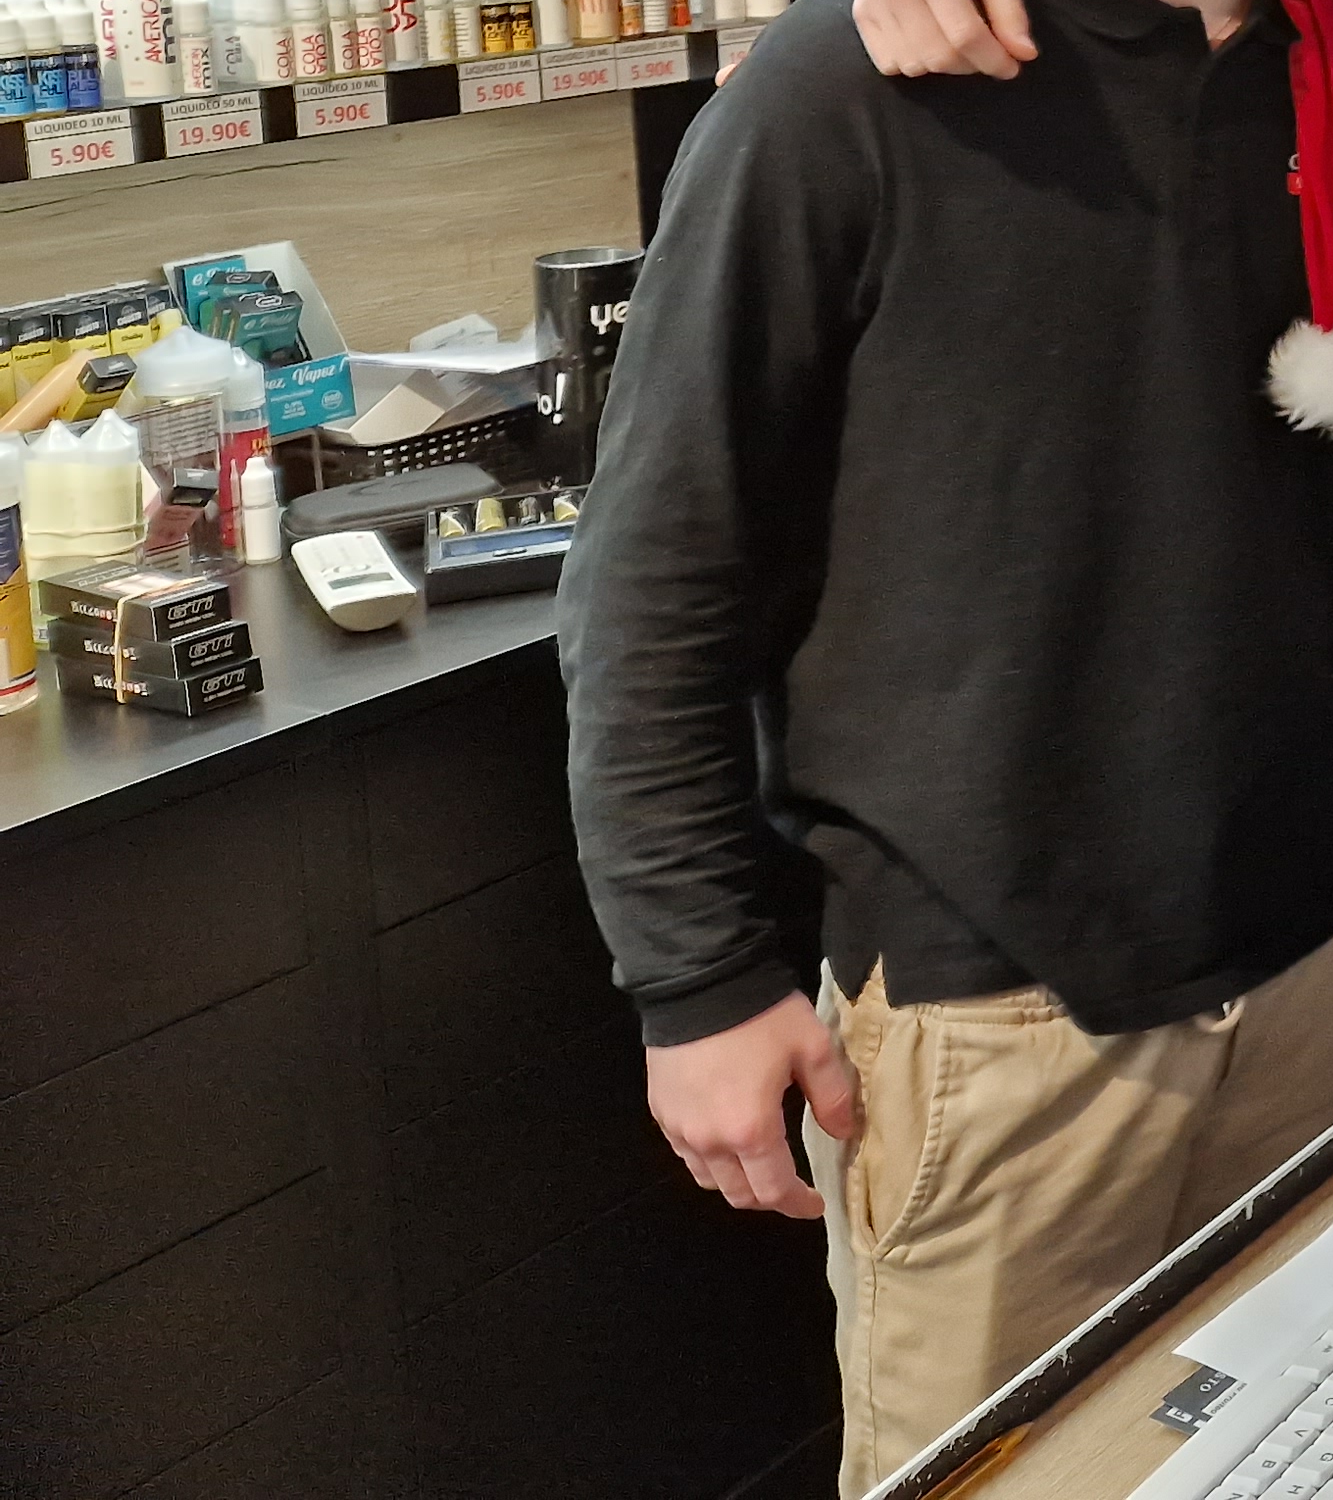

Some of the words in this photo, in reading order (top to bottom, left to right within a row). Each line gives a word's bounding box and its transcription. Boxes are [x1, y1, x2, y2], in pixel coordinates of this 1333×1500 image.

[302, 35, 316, 75] COLA
[342, 30, 354, 71] COLA
[552, 67, 609, 92] 19.90€
[631, 59, 674, 81] 5.90€
[302, 83, 349, 97] LIQUIDEO
[351, 81, 363, 91] 10
[364, 80, 380, 90] ML
[476, 81, 526, 102] 5.90€
[170, 96, 220, 116] LIQUIDEO
[221, 97, 237, 109] 50
[238, 95, 254, 108] ML
[314, 102, 372, 127] 5.90€
[34, 120, 88, 135] LIQUIDEO
[91, 118, 104, 127] 10
[106, 115, 124, 126] ML
[178, 120, 252, 147] 19.90€
[50, 140, 115, 167] 5.90€
[292, 364, 336, 386] Vapez
[1294, 1427, 1308, 1438] V
[1261, 1459, 1276, 1469] B
[1287, 1484, 1304, 1495] H
